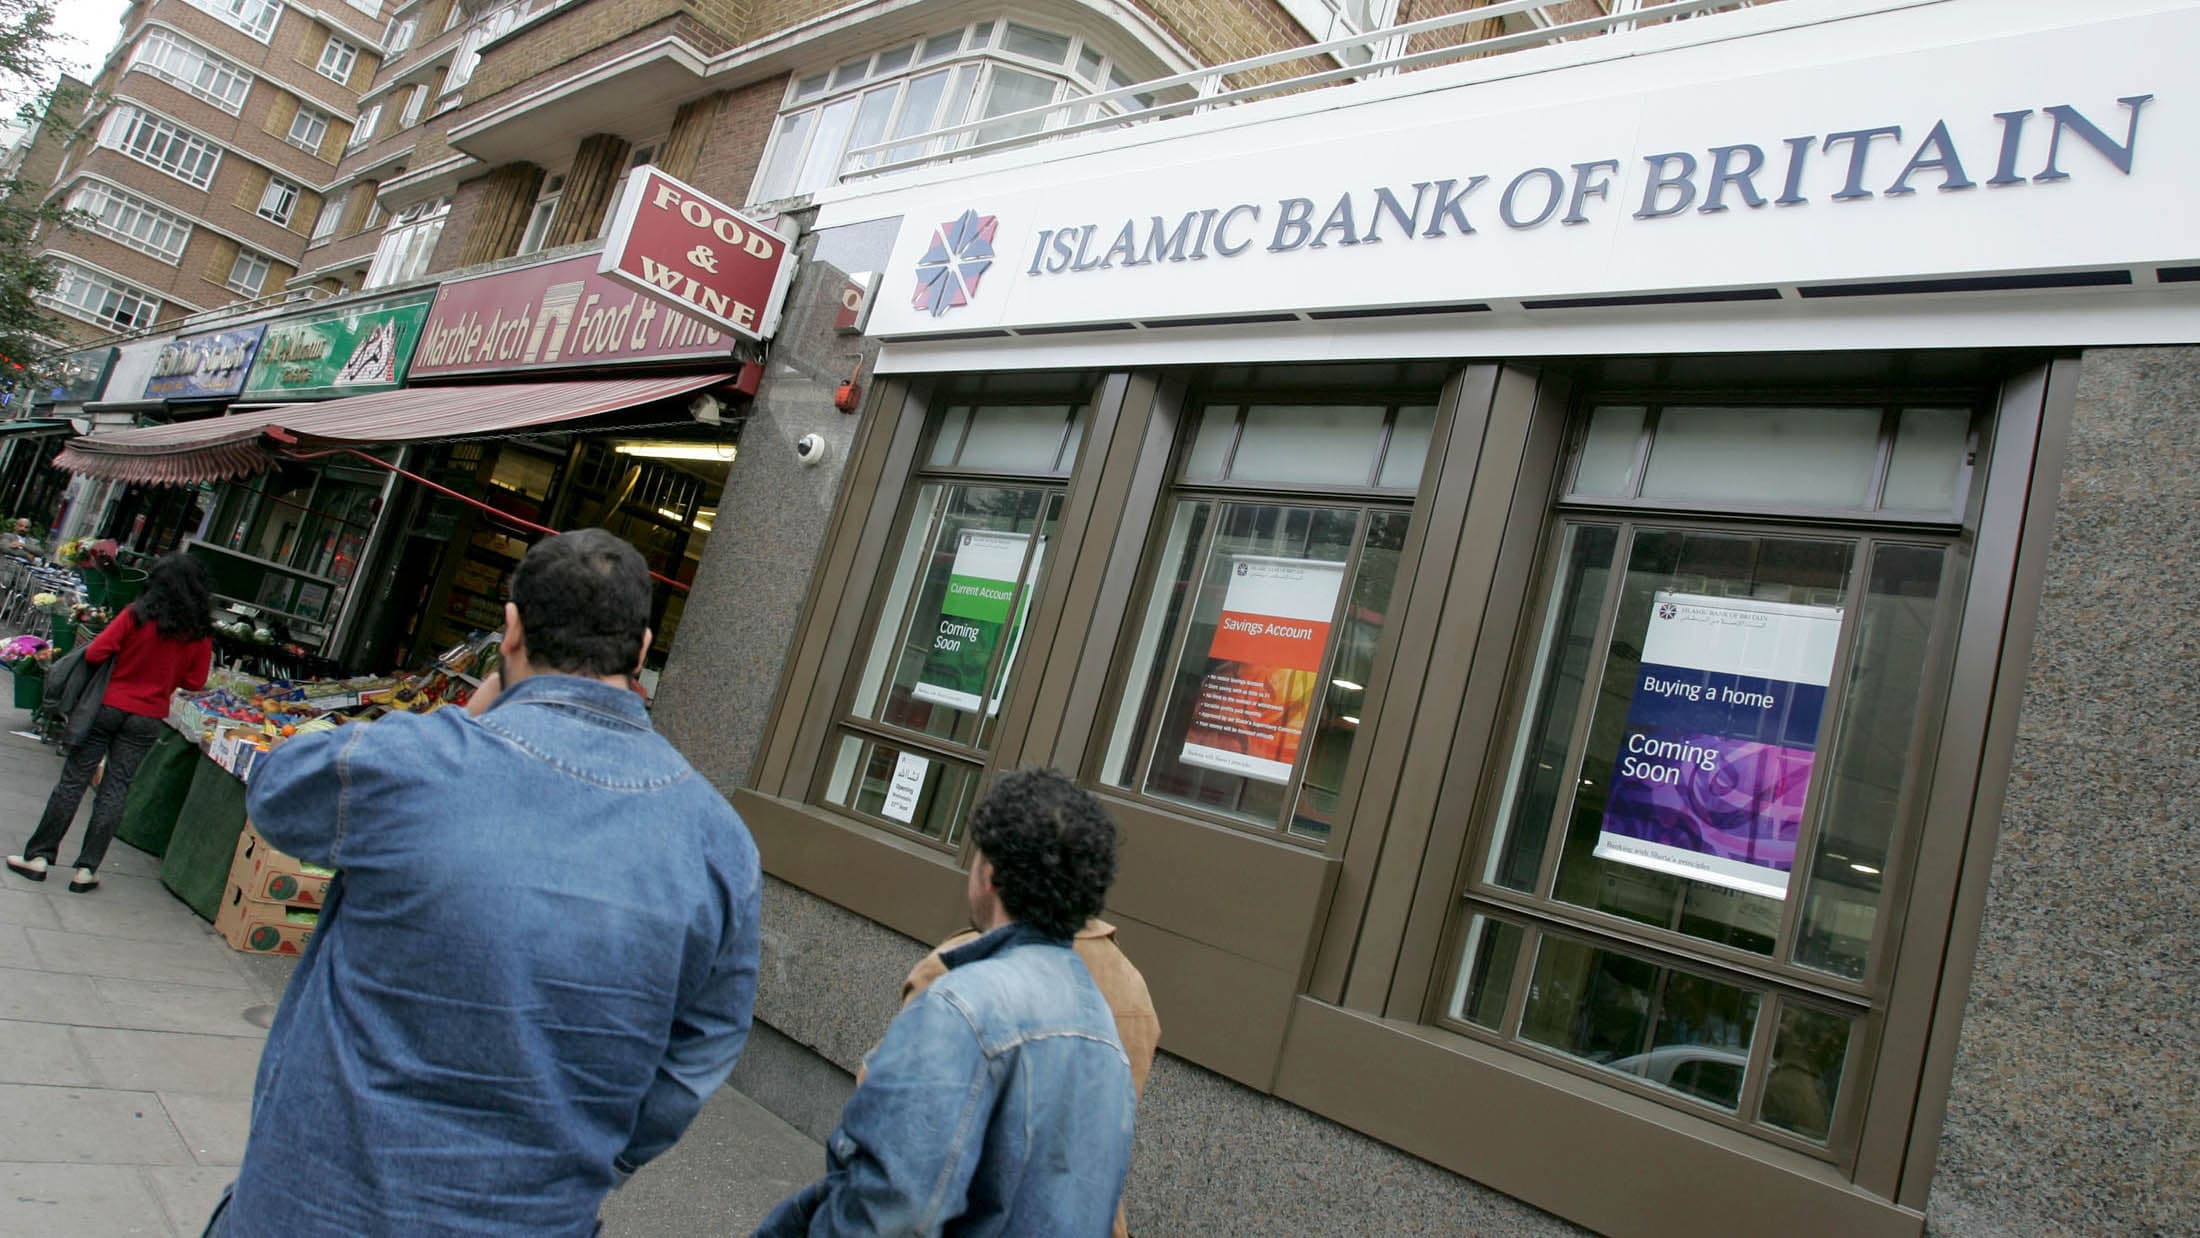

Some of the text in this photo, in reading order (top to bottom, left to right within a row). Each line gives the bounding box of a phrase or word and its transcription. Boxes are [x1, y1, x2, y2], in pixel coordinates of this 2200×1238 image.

[1026, 93, 2155, 277] ISLAMIC BANK OF BRITAIN
[652, 183, 774, 261] FOOD
[686, 245, 719, 275] &
[640, 255, 756, 331] WINE
[417, 311, 483, 368] Marble
[475, 303, 531, 363] Arch
[568, 293, 639, 356] Food
[630, 297, 657, 352] &
[950, 582, 1013, 601] Current Account
[934, 635, 961, 652] Soon
[940, 620, 980, 642] Coming
[1223, 617, 1313, 640] Savings Account
[1643, 675, 1775, 709] Buying a home
[1627, 732, 1719, 771] Coming
[1621, 756, 1680, 786] Soon
